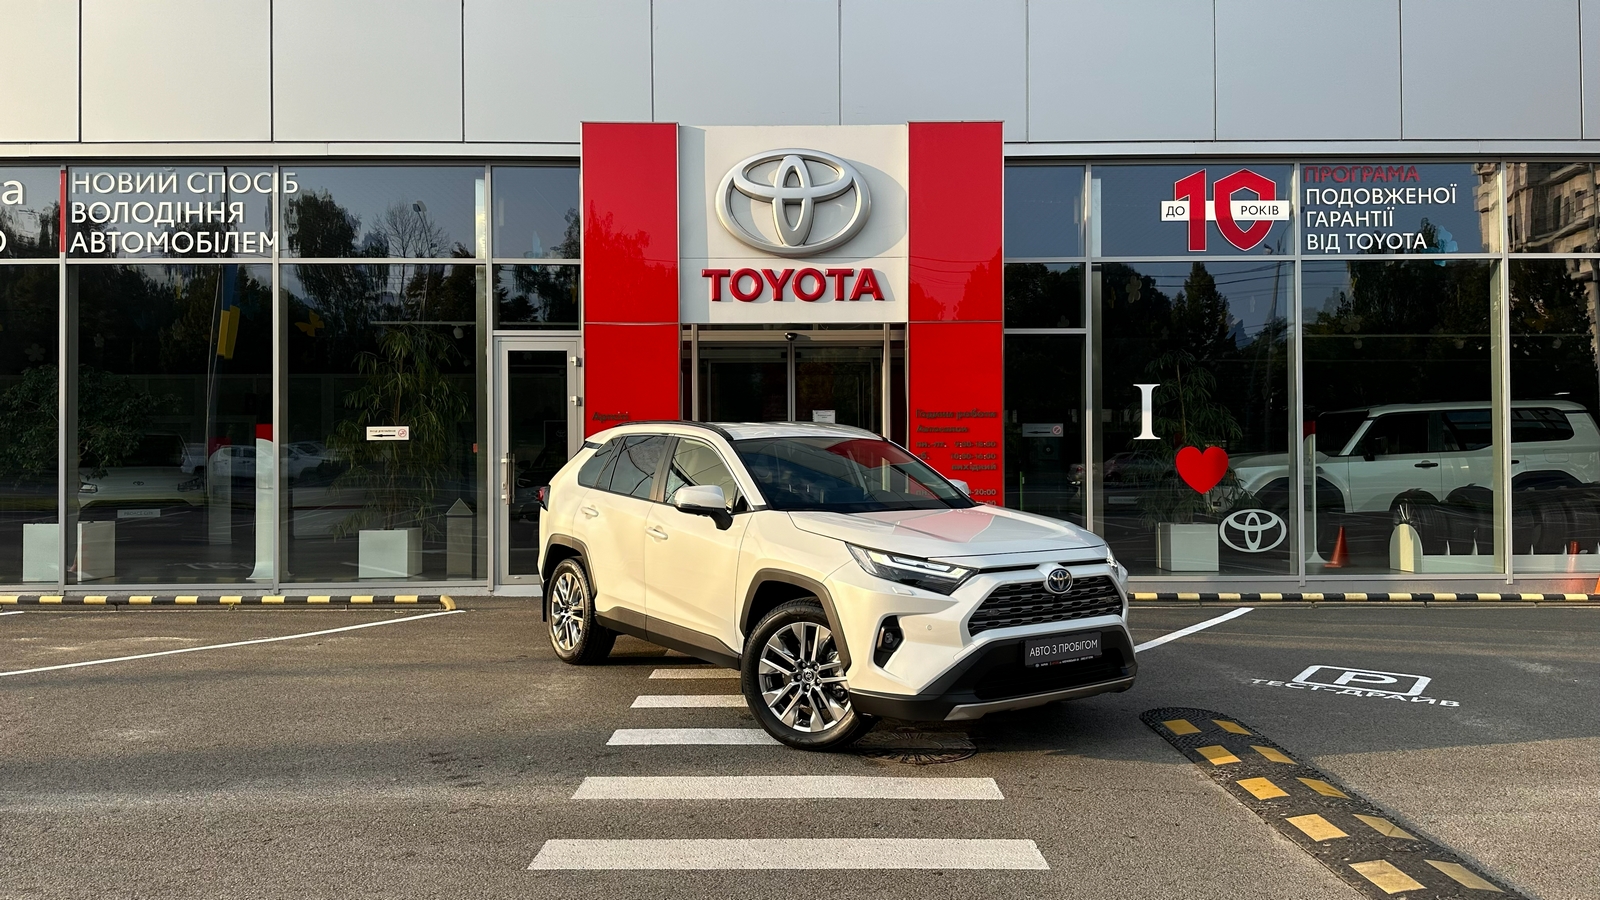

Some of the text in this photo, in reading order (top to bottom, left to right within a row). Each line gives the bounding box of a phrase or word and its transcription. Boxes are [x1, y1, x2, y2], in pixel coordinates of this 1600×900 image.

[71, 166, 298, 194] НОВИЙ СПОСІБ
[1305, 166, 1420, 183] ПРОГРАМА
[1306, 183, 1458, 208] ПОДОВЖЕНОЇ
[71, 201, 244, 228] ВОЛОДІННЯ
[1166, 168, 1280, 251] ДО 10 РОКІВ
[1307, 206, 1395, 228] ГАРАНТІЇ
[69, 231, 278, 253] АВТОМОБІЛЕМ
[1307, 233, 1428, 253] ВІД TOYOTA
[701, 267, 885, 302] TOYOTA
[1133, 384, 1161, 440] I
[1029, 645, 1051, 657] АВТО
[1058, 639, 1098, 653] ПРОБІГОМ
